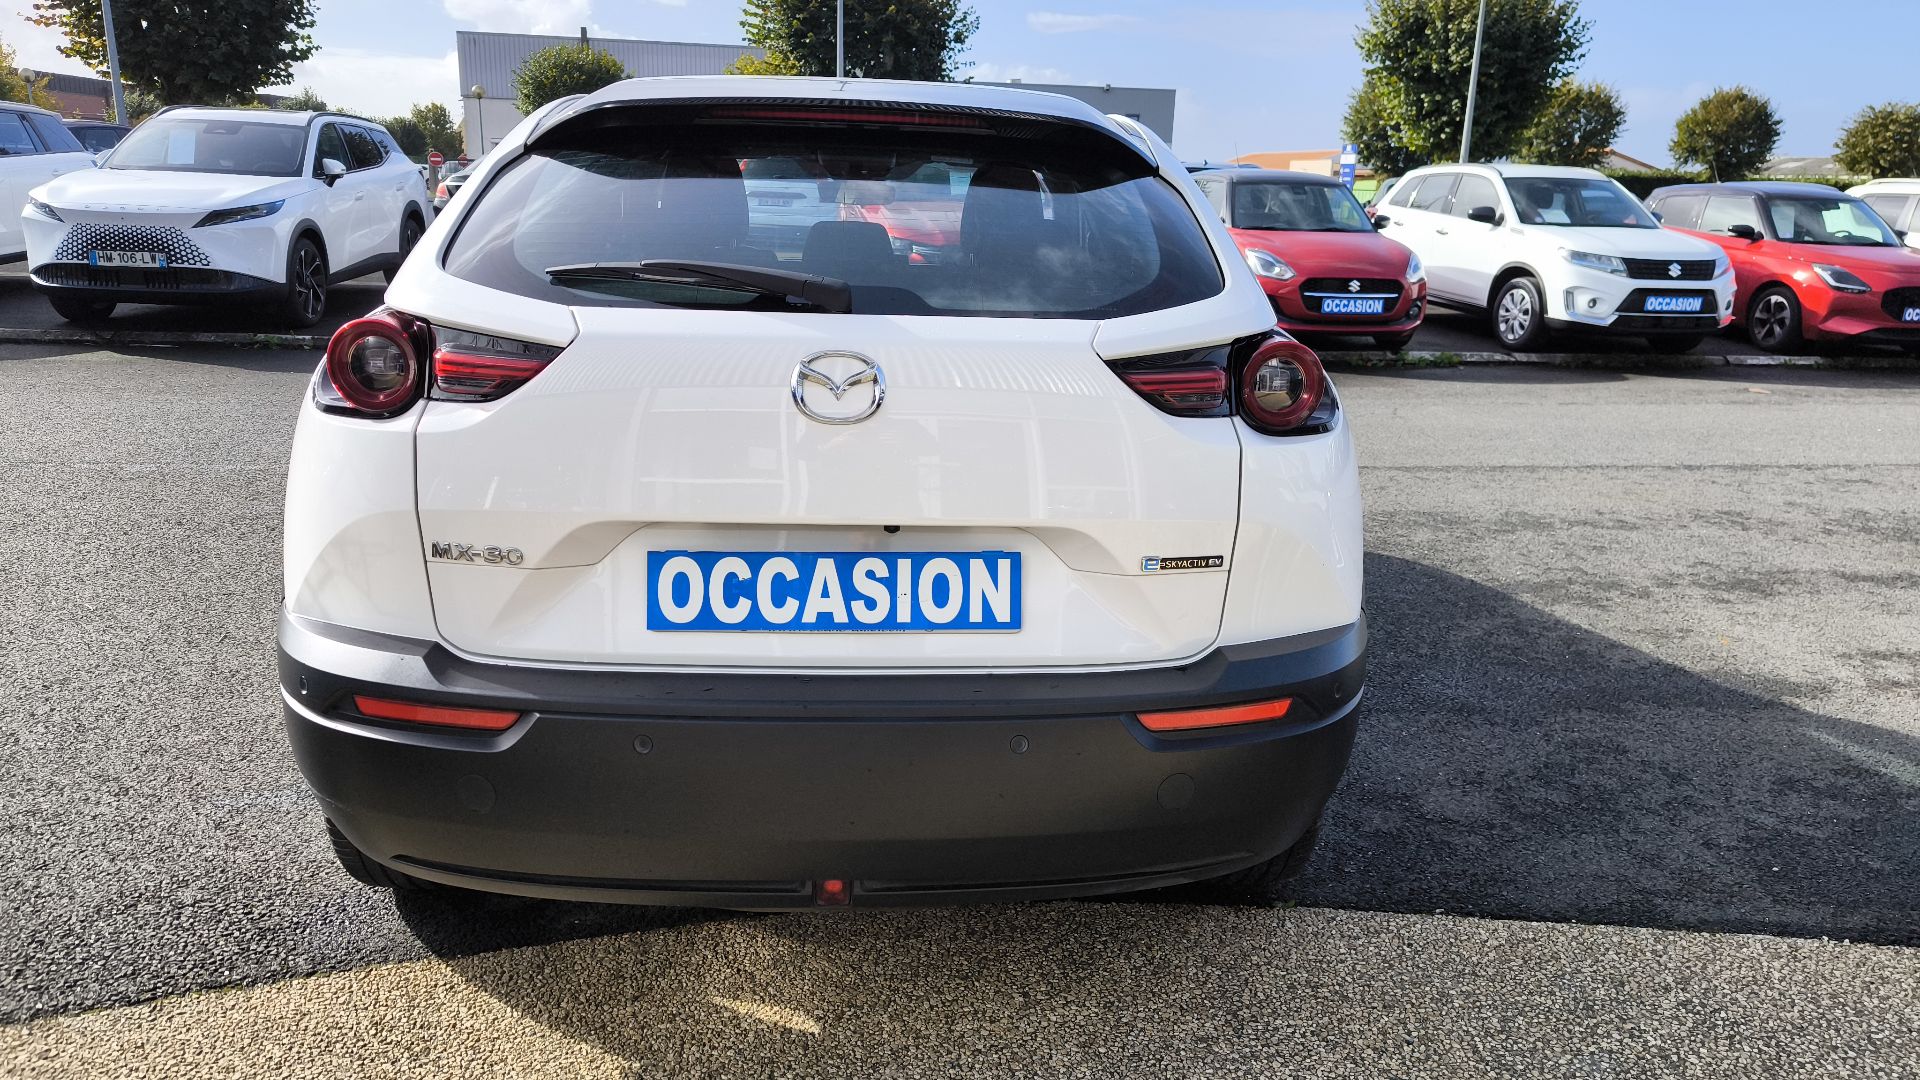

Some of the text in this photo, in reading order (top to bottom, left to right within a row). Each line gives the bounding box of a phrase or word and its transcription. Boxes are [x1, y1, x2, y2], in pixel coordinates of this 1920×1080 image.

[1324, 299, 1384, 313] OCCASION
[1647, 297, 1702, 311] OCCASION
[431, 541, 524, 566] MX-30
[1208, 558, 1222, 566] EV
[657, 556, 1011, 624] OCCASION
